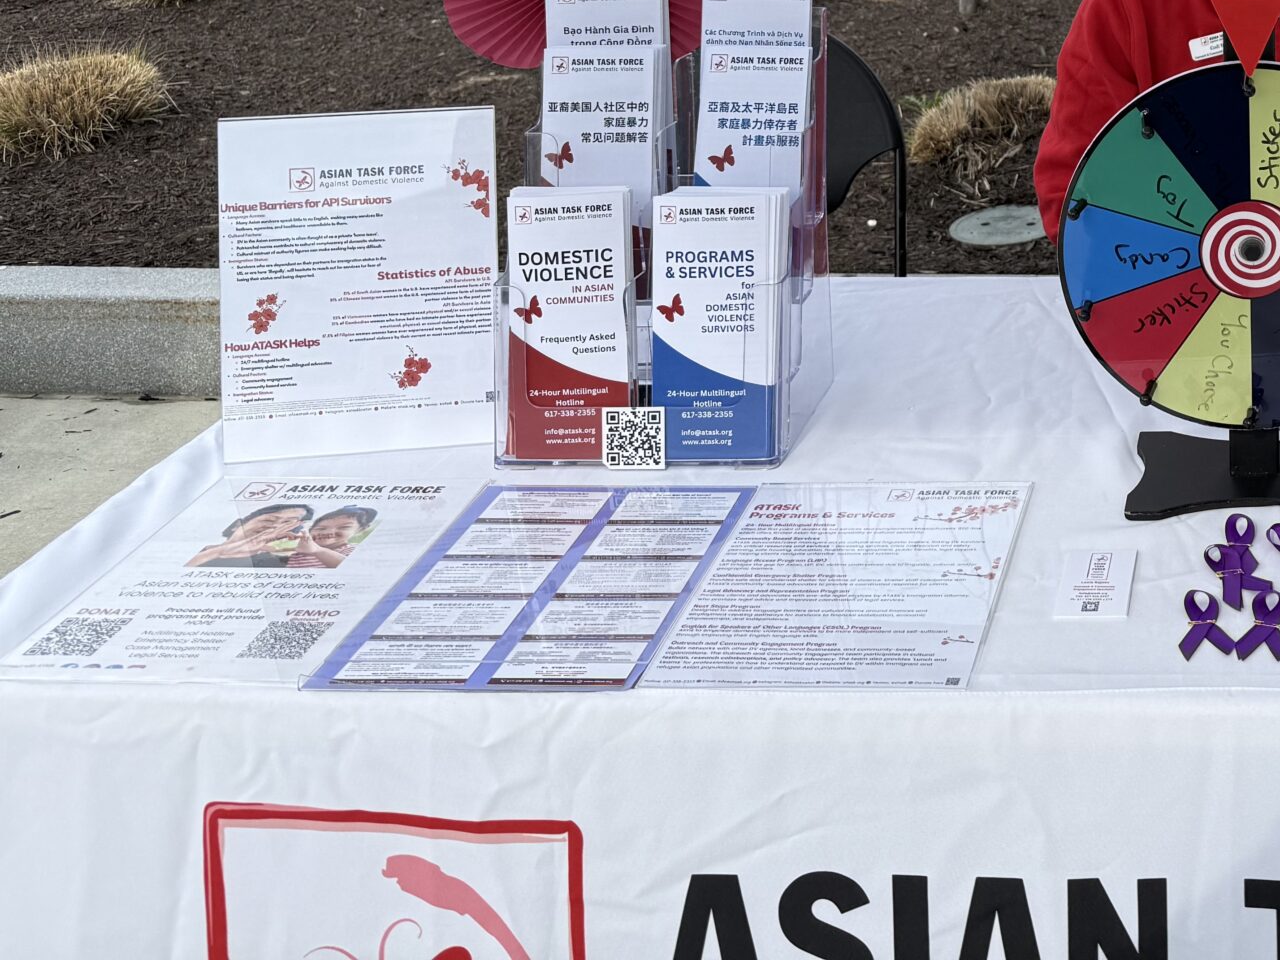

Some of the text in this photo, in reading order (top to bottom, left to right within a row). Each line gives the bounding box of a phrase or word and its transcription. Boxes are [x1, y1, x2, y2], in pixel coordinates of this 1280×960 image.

[563, 25, 655, 36] Bạo Hành Gia Đình
[571, 58, 644, 66] ASIAN TASK FORCE
[730, 56, 804, 65] ASIAN TASK FORCE
[548, 101, 649, 113] 亚裔美国人社区中的
[707, 101, 799, 114] 亞裔及太平洋島民
[603, 116, 648, 128] 家庭暴力
[581, 132, 648, 143] 常见问题解答
[319, 164, 424, 179] ASIAN TASK FORCE
[319, 176, 424, 189] Against Domestic Violence
[220, 195, 392, 214] Unique Barriers for API Survivors
[534, 203, 612, 215] ASIAN TASK FORCE
[679, 208, 702, 216] ASIAN
[728, 206, 755, 215] FORCE
[518, 248, 613, 266] DOMESTIC
[666, 249, 755, 263] PROGRAMS
[1114, 243, 1191, 271] Candy
[377, 268, 436, 281] Statistics
[453, 266, 491, 276] Abuse
[522, 264, 614, 282] VIOLENCE
[665, 265, 755, 279] & SERVICES
[572, 283, 614, 294] IN ASIAN
[741, 281, 755, 290] for
[546, 294, 615, 305] COMMUNITIES
[725, 292, 754, 301] ASIAN
[705, 302, 755, 312] DOMESTIC
[1133, 281, 1209, 334] Sticker
[707, 313, 755, 323] VIOLENCE
[701, 323, 755, 334] SURVIVORS
[540, 332, 616, 344] Frequently Asked
[224, 338, 321, 352] How ATASK Helps
[572, 345, 617, 356] Questions
[529, 386, 609, 397] 24-Hour Multilingual
[700, 389, 747, 398] Multilingual
[555, 398, 585, 406] Hotline
[692, 400, 722, 408] Hotline
[544, 408, 596, 418] 617-338-2355
[681, 410, 734, 419] 617-338-2355
[544, 427, 596, 436] info@atask.org
[681, 429, 733, 437] info@atask.org
[682, 438, 732, 446] www.atask.org
[284, 484, 446, 494] ASIAN TASK FORCE
[748, 511, 819, 521] Programs
[836, 511, 895, 519] Services
[182, 571, 316, 580] ATASK empowers
[134, 580, 180, 588] Asian
[180, 581, 252, 589] survivors
[272, 581, 346, 591] domestic
[118, 590, 184, 598] violence
[264, 591, 303, 600] their
[301, 591, 340, 600] lives.
[76, 608, 141, 616] DONATE
[286, 609, 341, 618] VENMO
